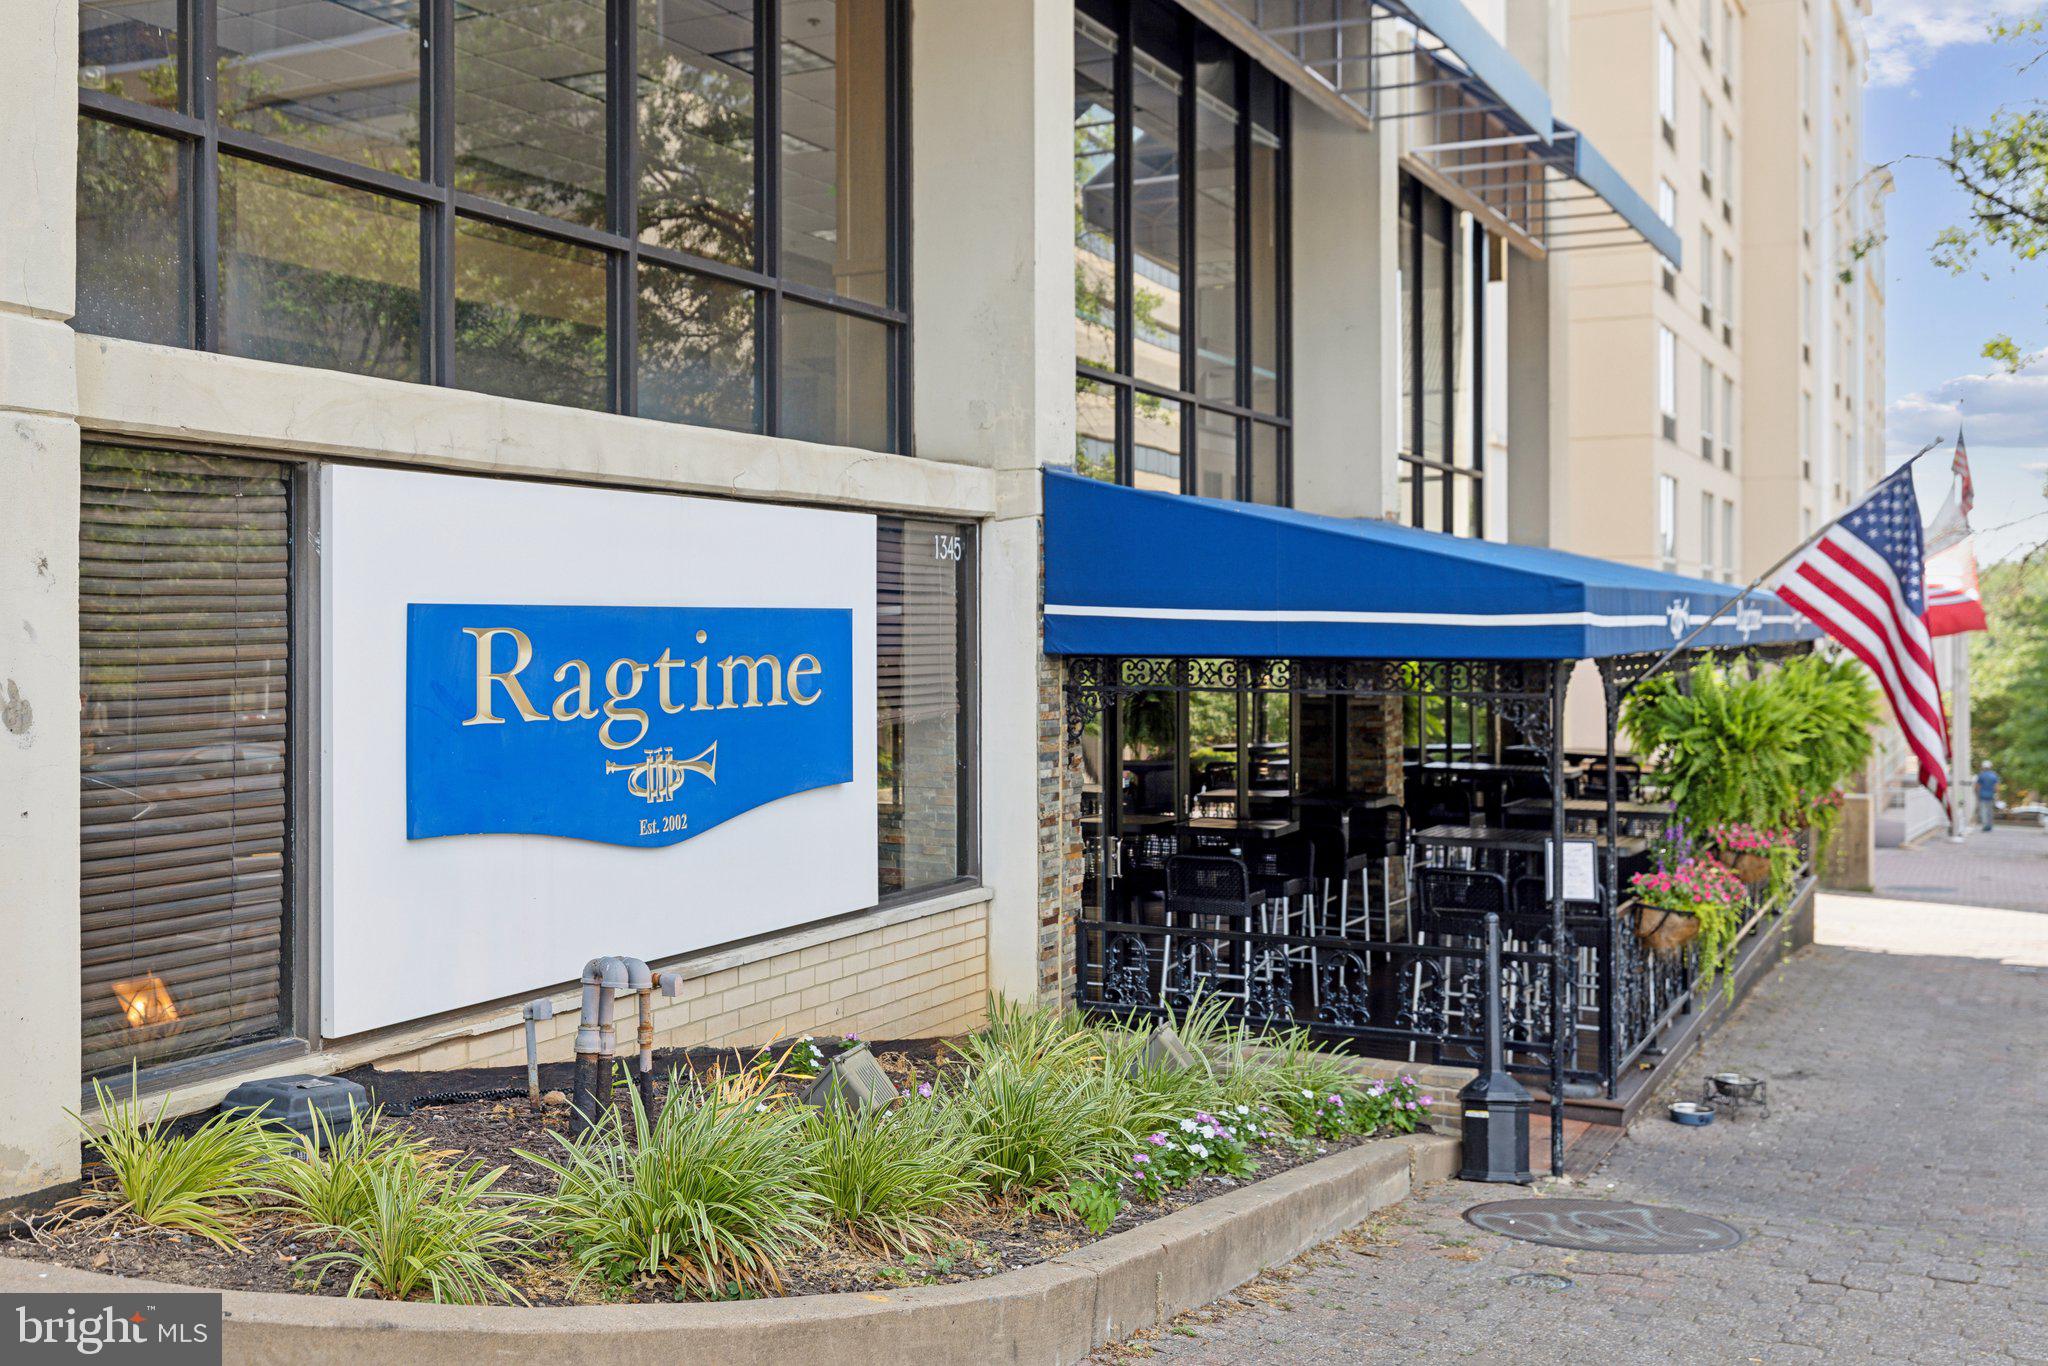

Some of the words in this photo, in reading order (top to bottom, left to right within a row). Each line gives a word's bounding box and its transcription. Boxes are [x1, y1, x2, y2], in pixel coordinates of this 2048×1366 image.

[934, 534, 962, 561] 1345
[461, 627, 823, 750] Ragtime
[639, 818, 660, 836] Est.
[662, 813, 688, 833] 2002
